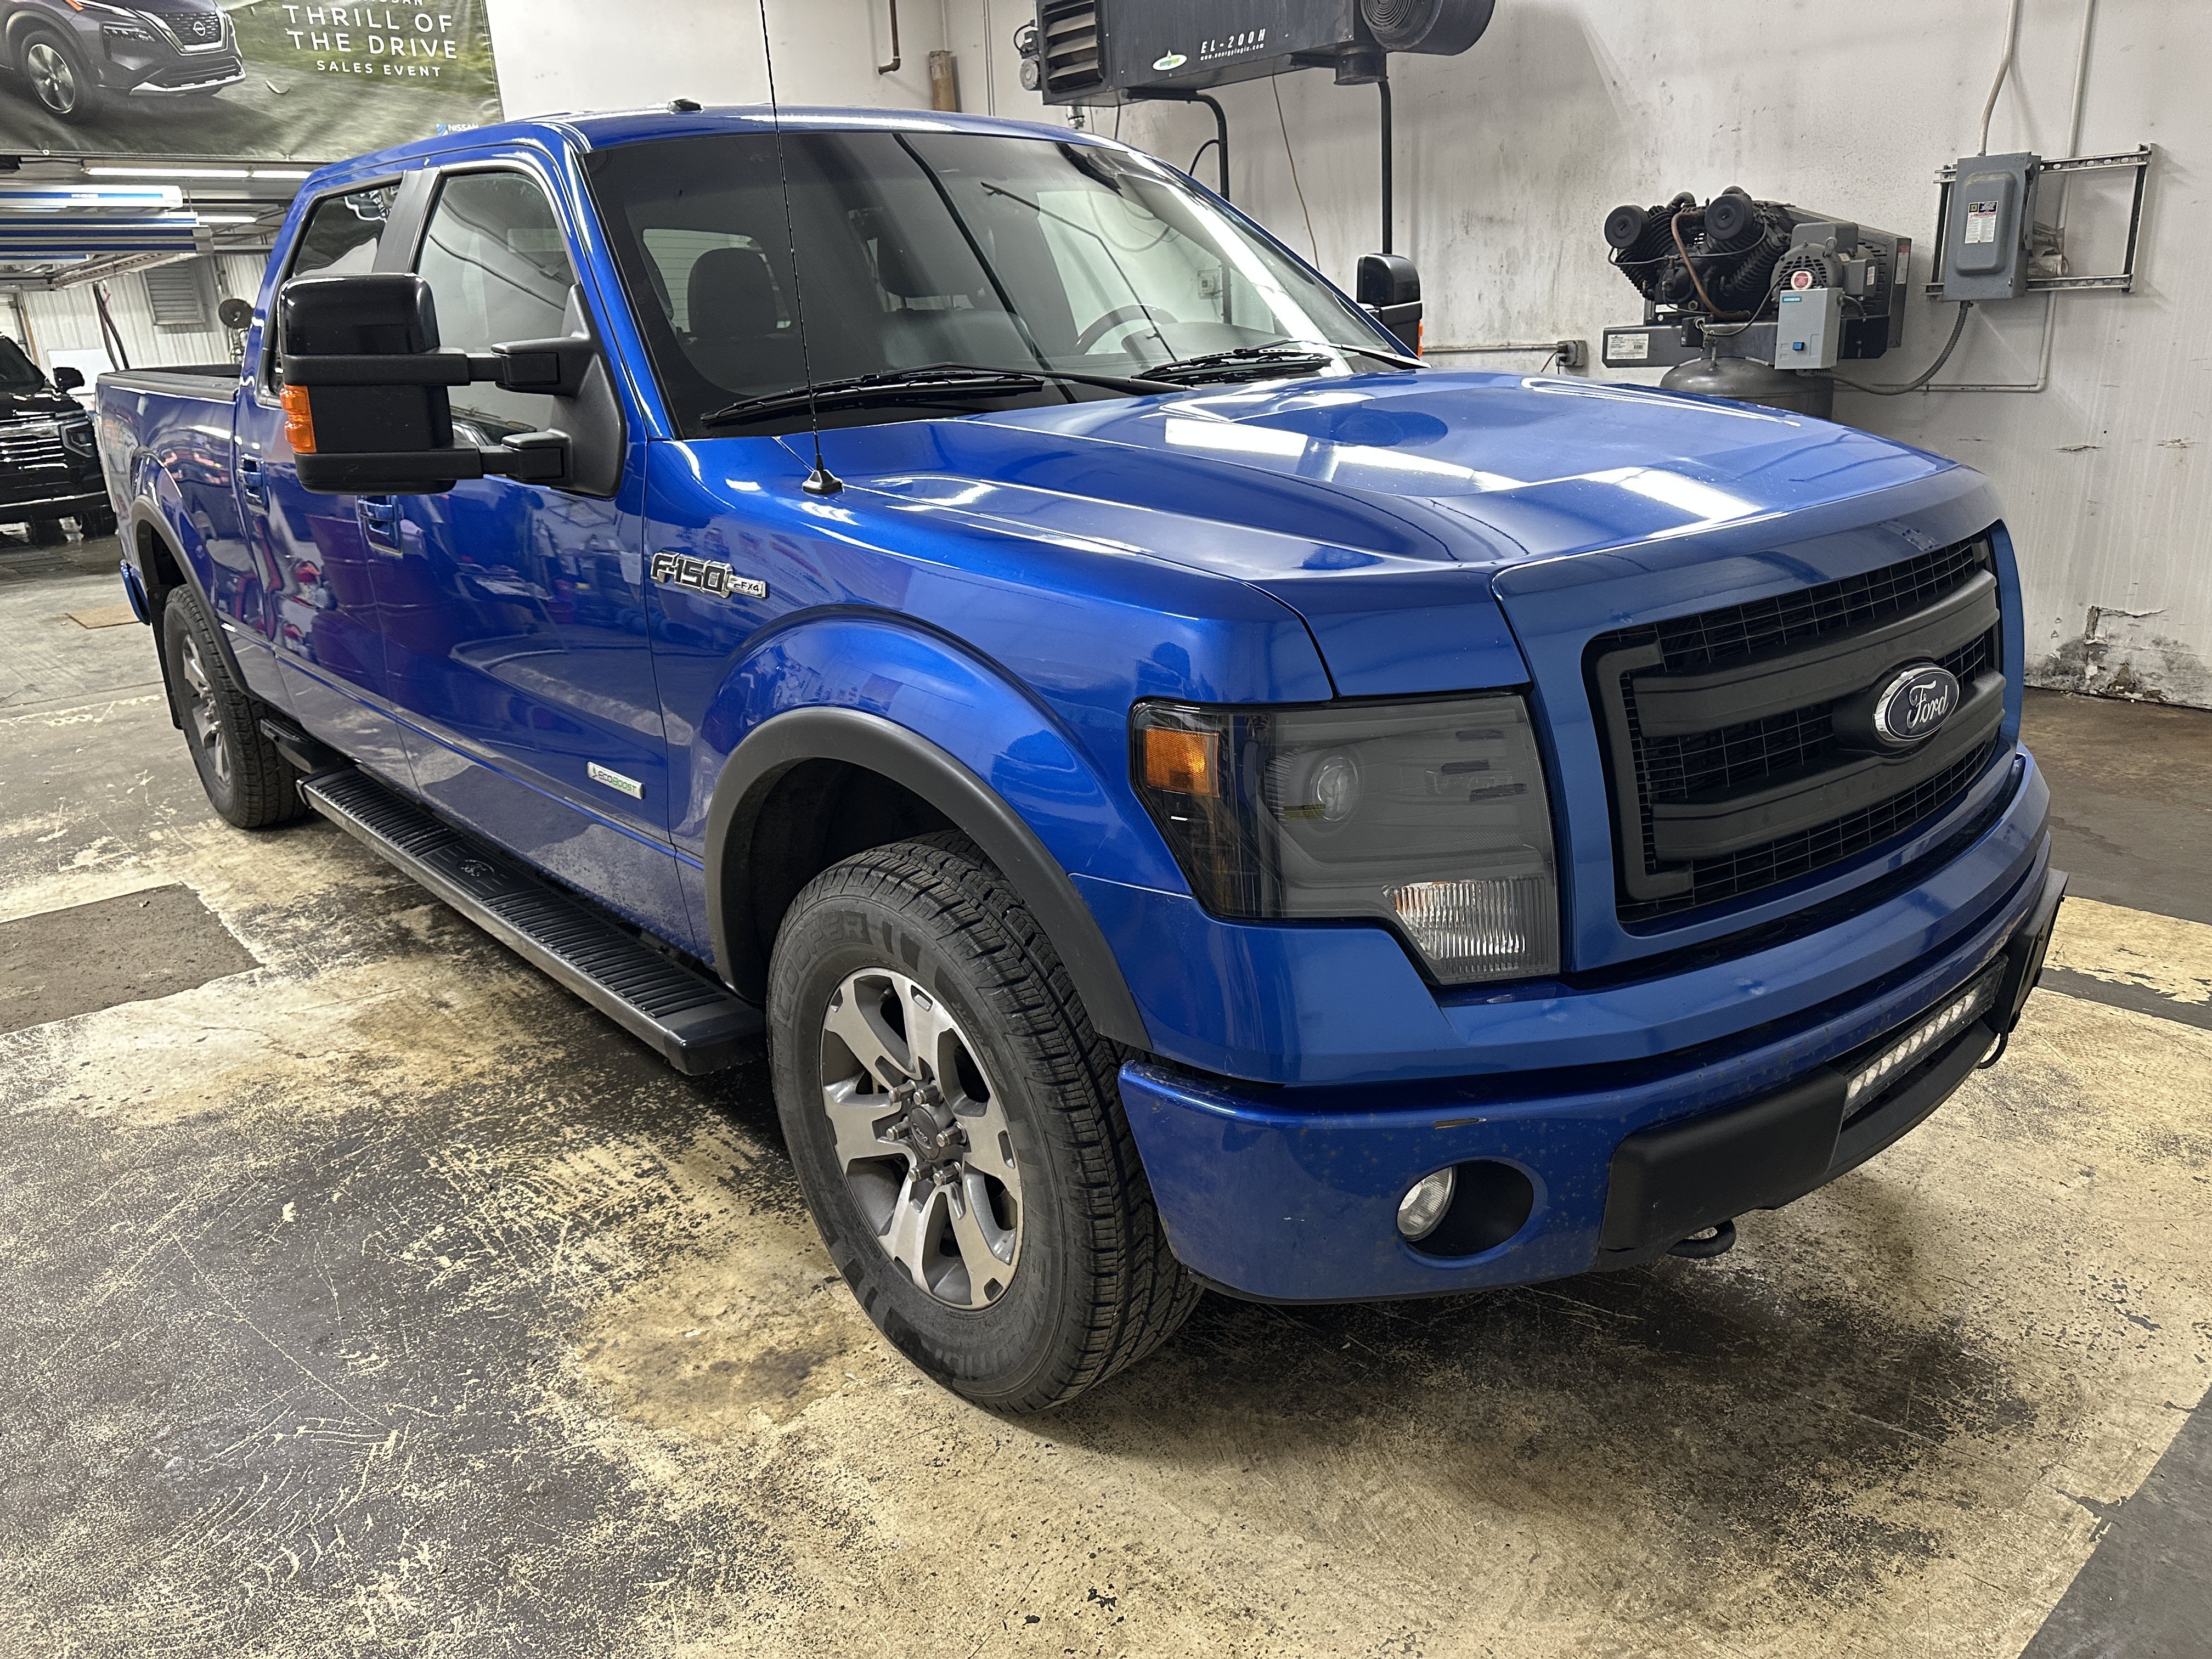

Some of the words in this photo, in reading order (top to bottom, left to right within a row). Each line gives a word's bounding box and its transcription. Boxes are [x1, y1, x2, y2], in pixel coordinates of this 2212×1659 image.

[282, 4, 400, 30] THRILL
[414, 13, 452, 33] OF
[286, 31, 352, 52] THE
[368, 35, 458, 59] DRIVE
[1200, 28, 1266, 54] EL-200H
[317, 60, 373, 74] SALES
[383, 64, 441, 77] EVENT
[448, 123, 479, 132] NISSAN
[741, 582, 760, 592] FX4
[1906, 680, 1949, 729] Ford
[598, 770, 637, 792] ECOBOOST
[777, 915, 867, 1023] COOPER
